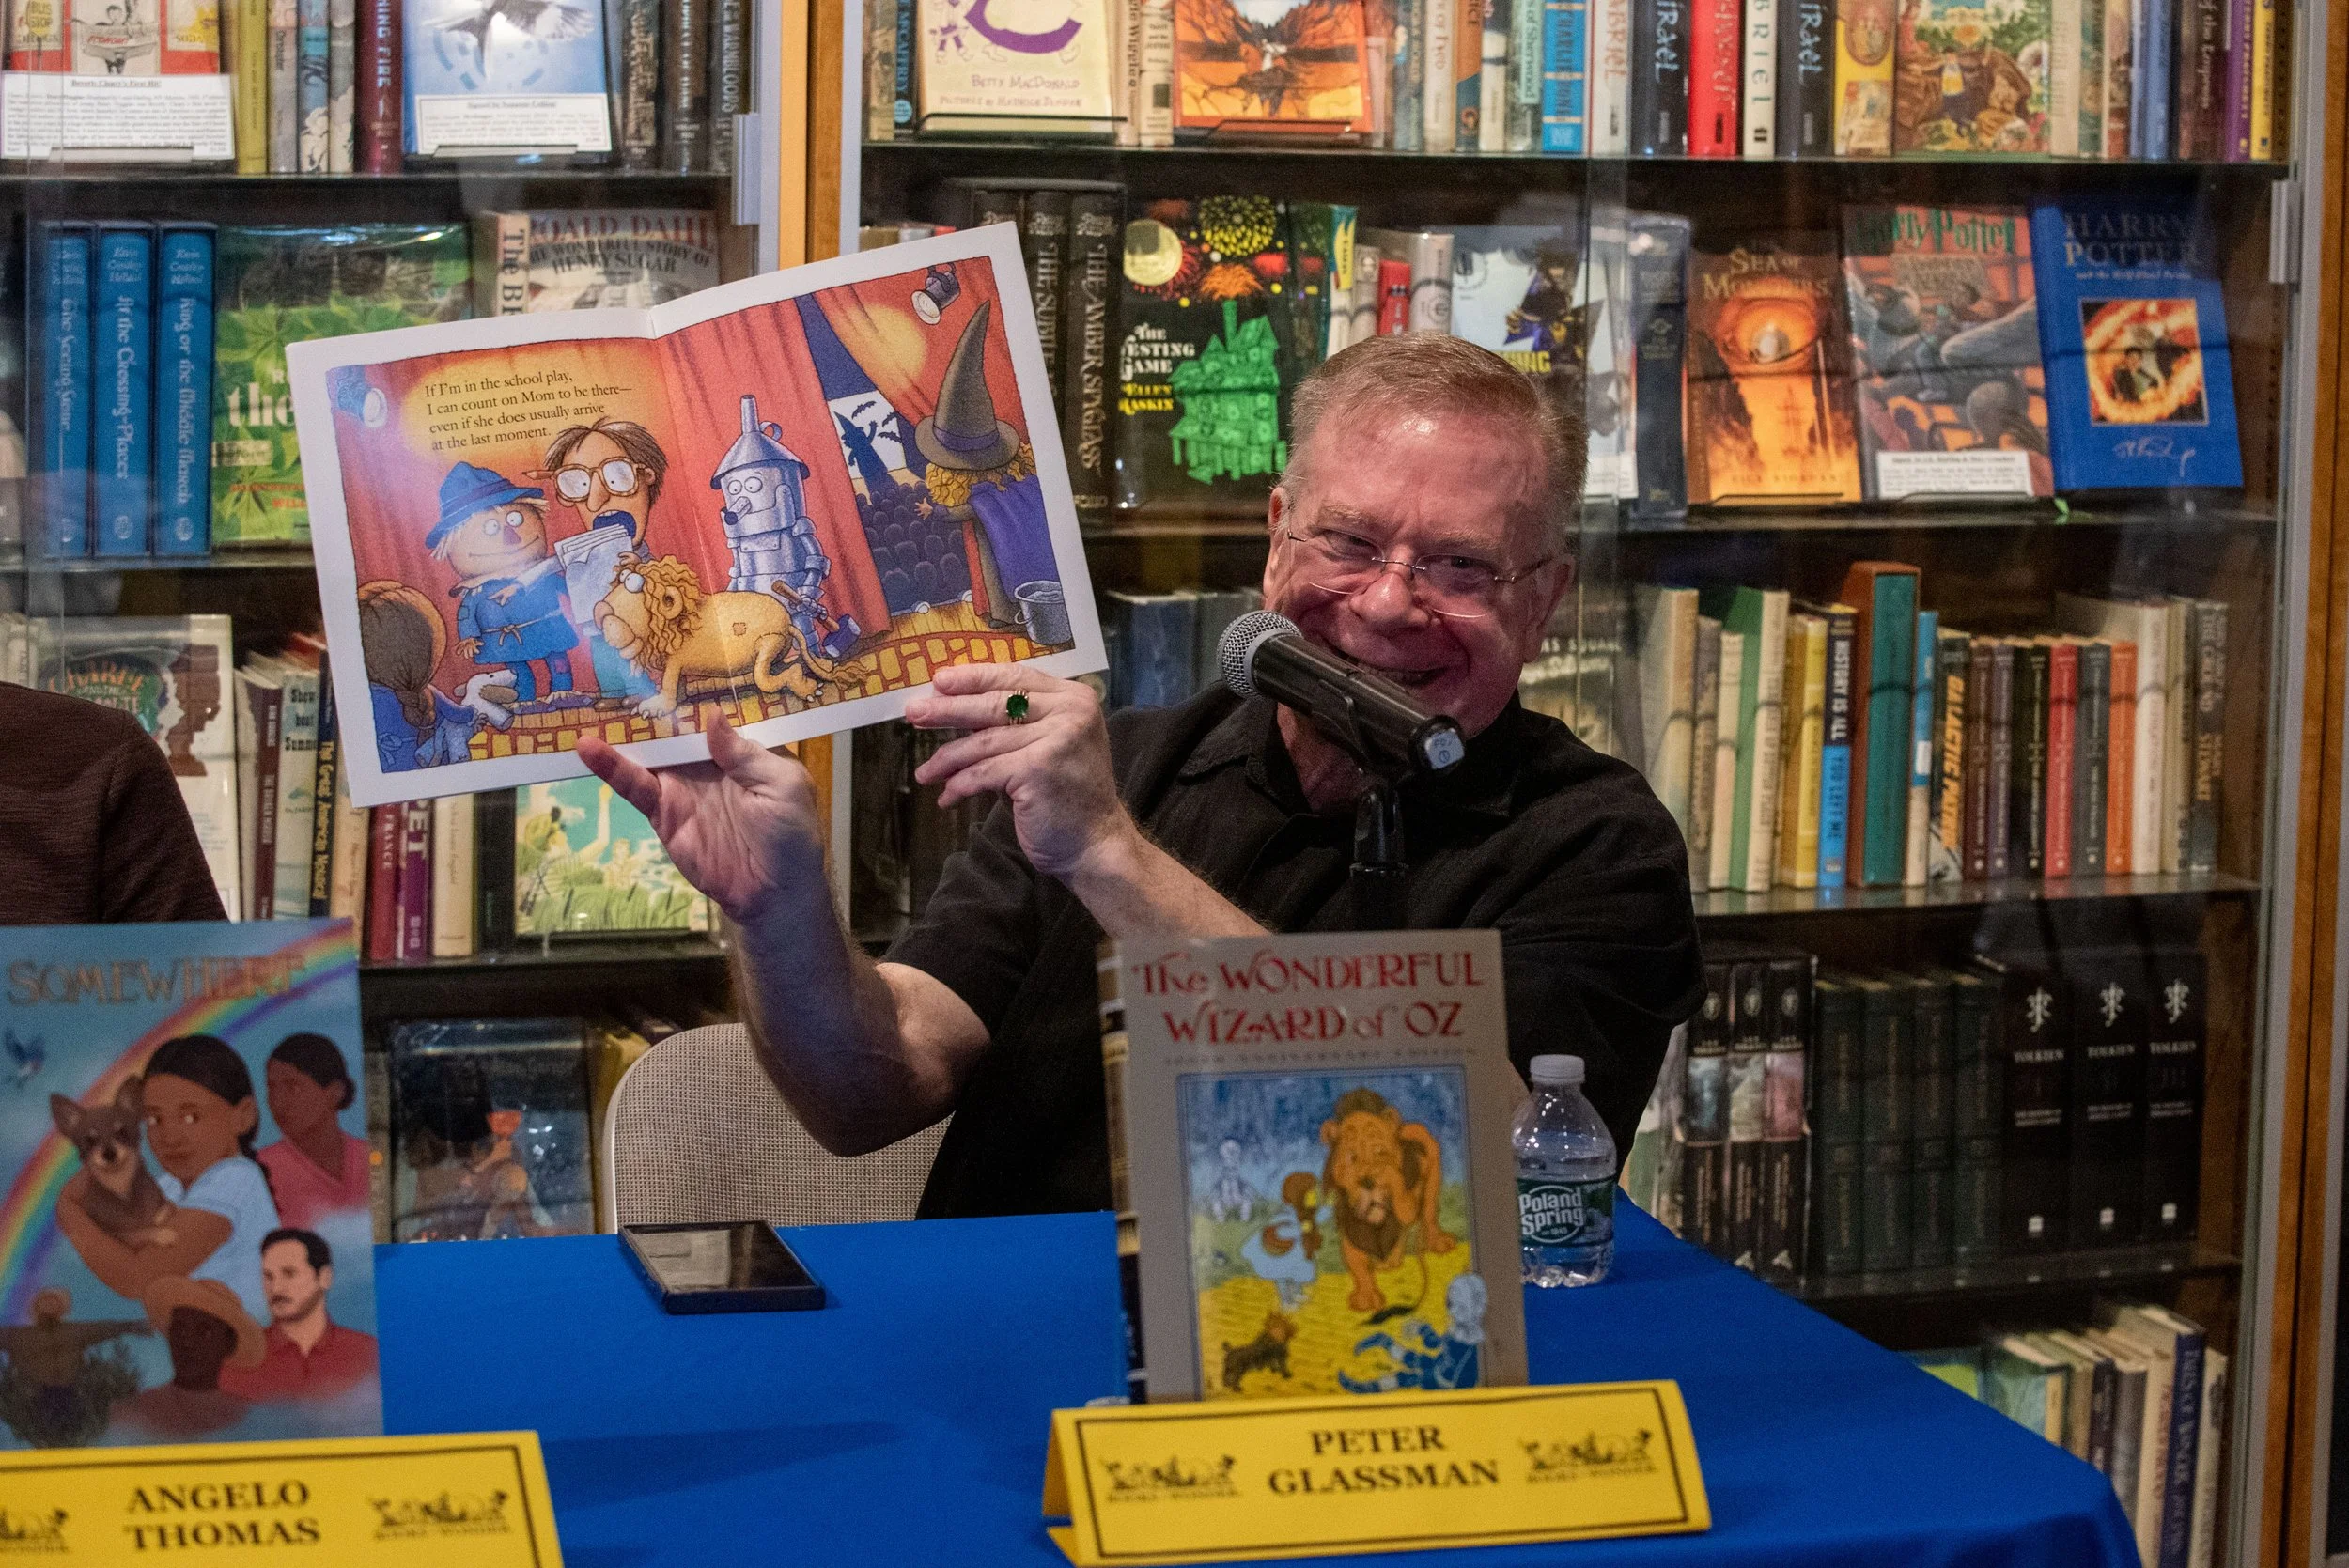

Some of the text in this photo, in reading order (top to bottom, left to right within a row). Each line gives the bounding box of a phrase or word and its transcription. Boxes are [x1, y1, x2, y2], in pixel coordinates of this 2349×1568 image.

[1524, 27, 1538, 99] Sherwood
[630, 214, 716, 254] DAHL
[1927, 208, 2016, 254] Potter
[503, 228, 525, 275] The
[552, 252, 677, 275] HENRY SUGAR
[1081, 244, 1108, 293] THE
[1729, 247, 1780, 275] SEA
[1080, 293, 1107, 378] AMBER
[1134, 322, 1167, 340] THE
[424, 383, 437, 398] If
[464, 381, 477, 394] in
[480, 377, 501, 393] the
[503, 371, 543, 389] school
[546, 370, 573, 387] play,
[427, 403, 434, 416] I
[436, 403, 459, 415] can
[460, 396, 498, 411] count
[501, 396, 518, 406] on
[521, 389, 556, 404] Mom
[558, 387, 571, 400] to
[574, 384, 589, 398] be
[429, 403, 606, 434] even if she does usually arrive
[1078, 374, 1106, 477] SPYGLASS
[431, 426, 552, 452] at the last moment.
[1829, 639, 1850, 741] HISTORY IS ALL
[1943, 675, 1966, 777] GALACTIC
[320, 740, 334, 761] The
[318, 763, 333, 797] Great
[315, 800, 332, 851] American
[382, 813, 396, 871] FRANCE
[1133, 947, 1485, 996] The WONDERFUL
[1163, 999, 1346, 1047] WIZARD
[1404, 1001, 1465, 1038] OZ
[1518, 1188, 1583, 1214] Poland
[1520, 1207, 1584, 1236] Spring
[1309, 1424, 1449, 1457] PETER
[127, 1478, 312, 1514] ANGELO
[1268, 1459, 1501, 1498] GLASSMAN
[122, 1516, 322, 1552] THOMAS
